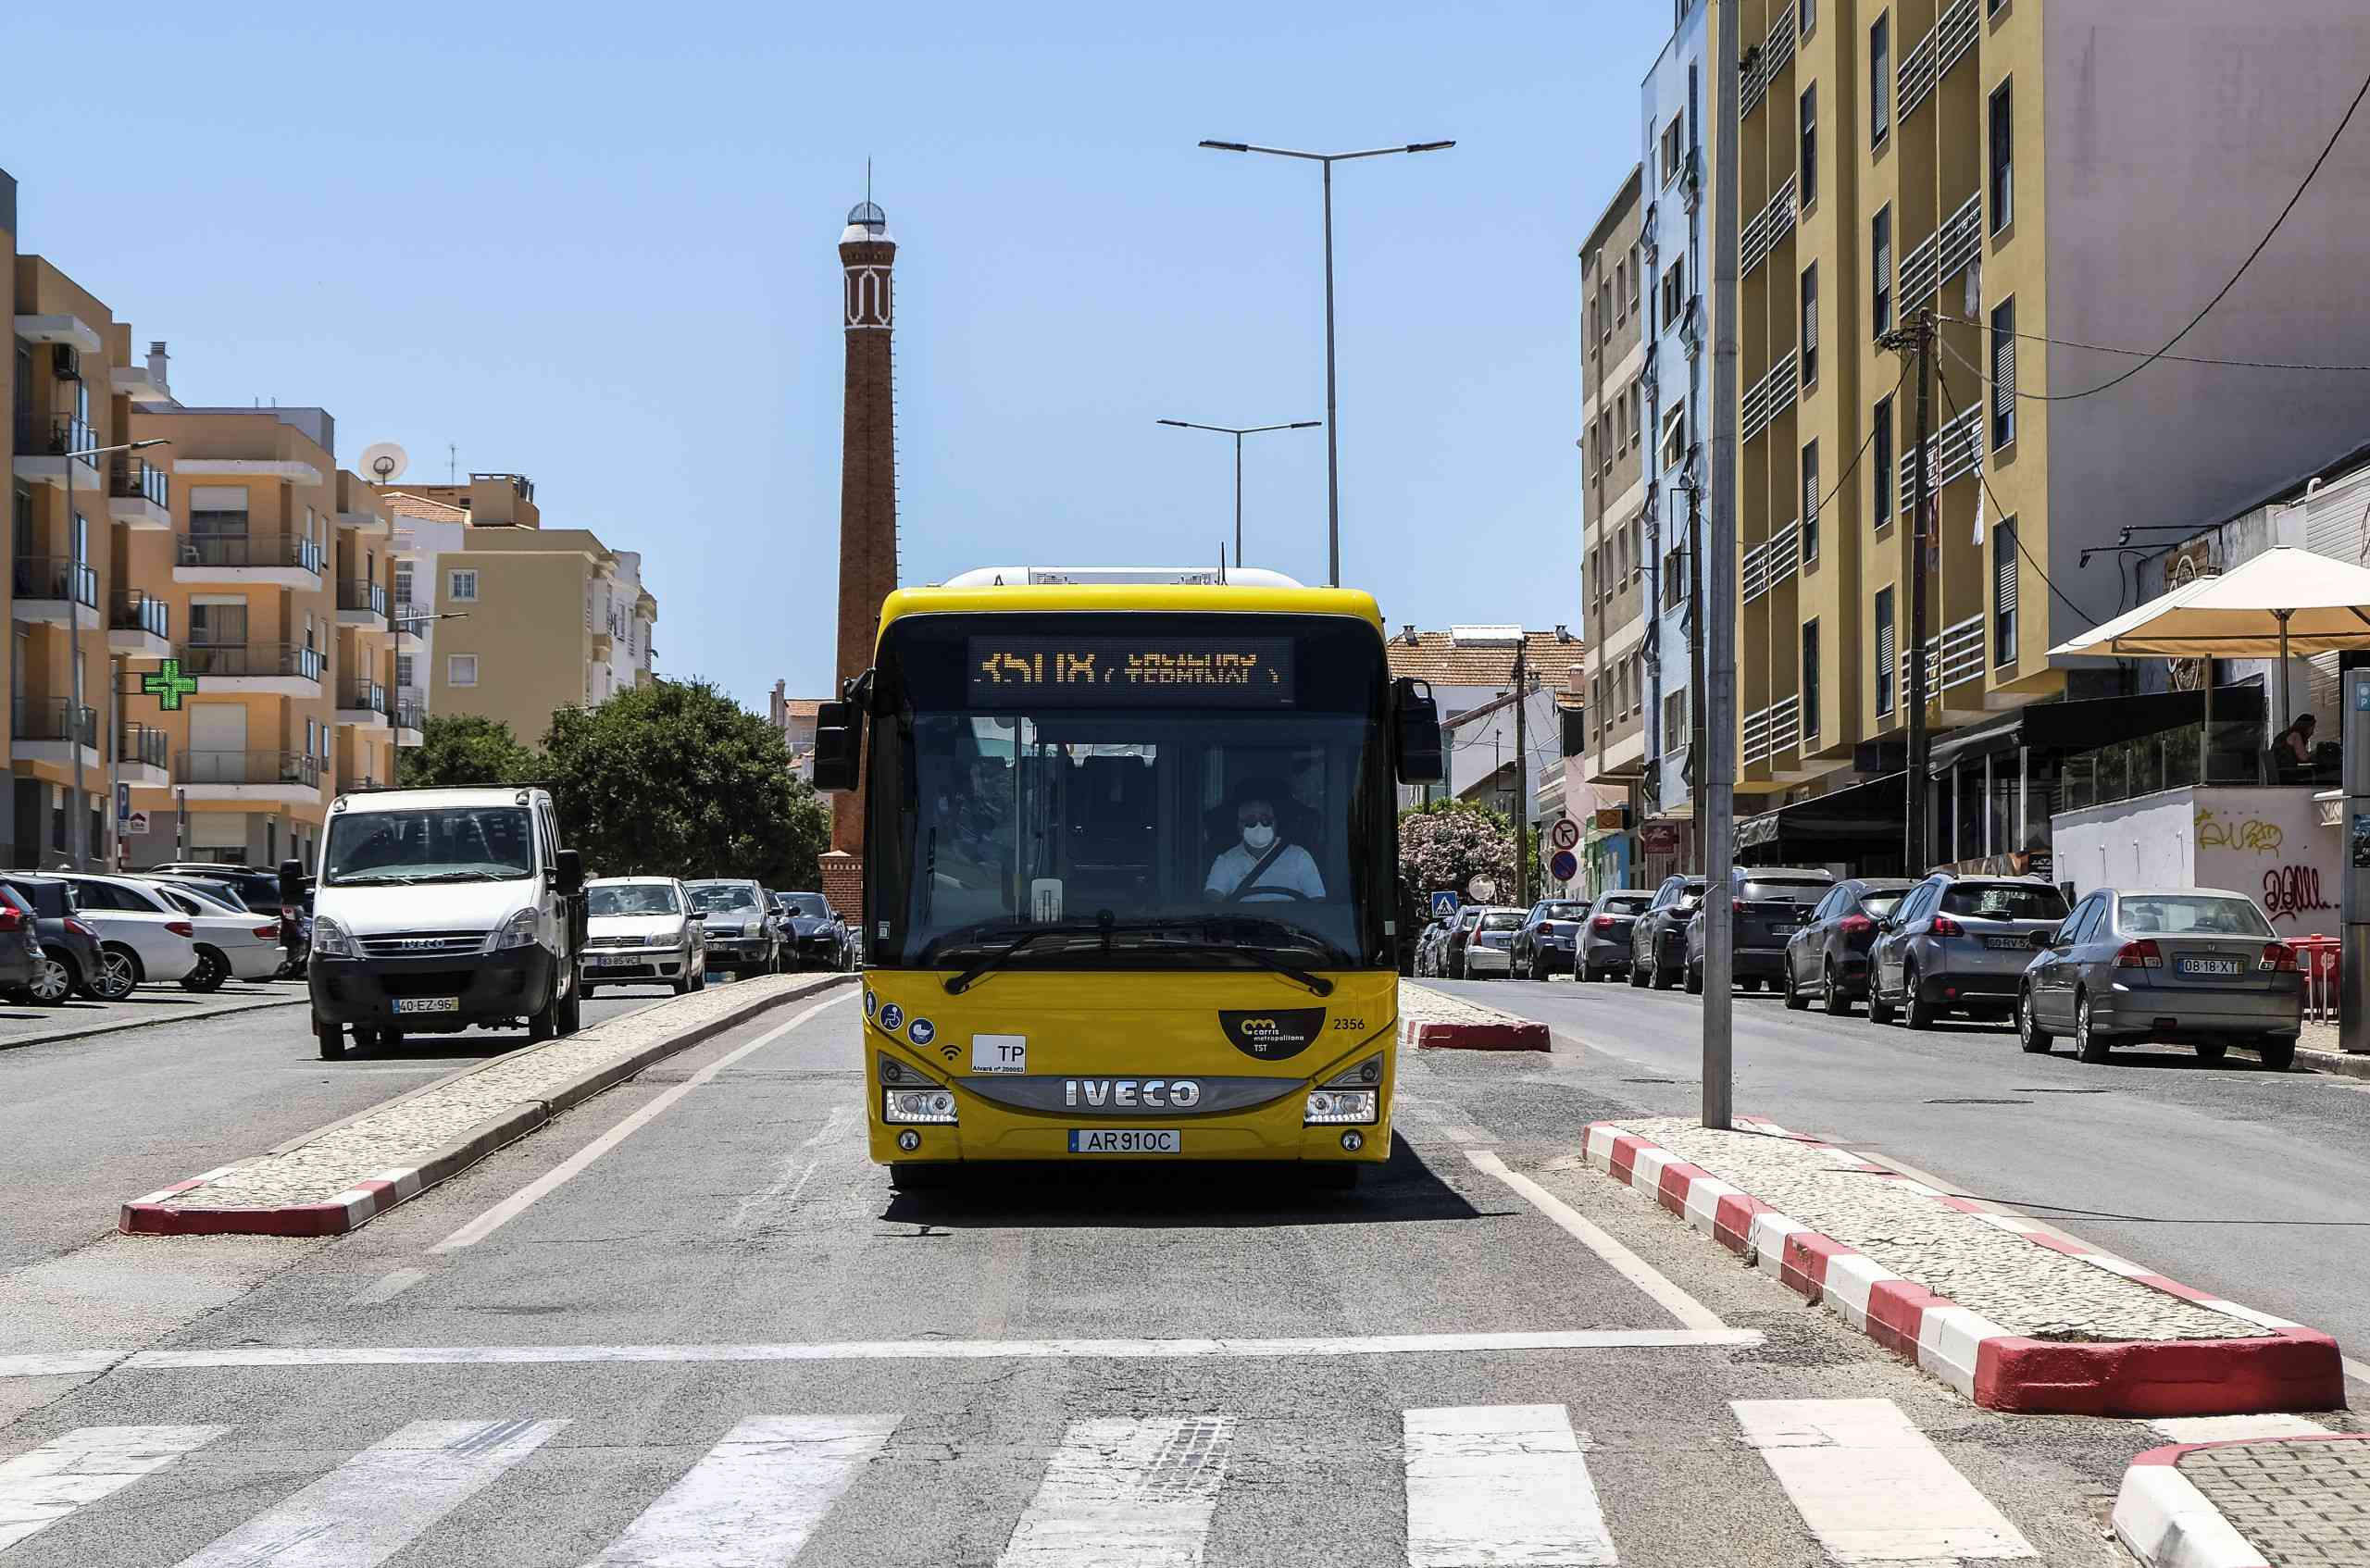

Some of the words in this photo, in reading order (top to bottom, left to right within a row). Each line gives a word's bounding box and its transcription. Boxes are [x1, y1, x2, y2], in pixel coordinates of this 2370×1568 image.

[1333, 1019, 1365, 1030] 2356
[1254, 1035, 1304, 1043] metropolitana
[997, 1045, 1025, 1063] TP
[1066, 1080, 1200, 1107] IVECO
